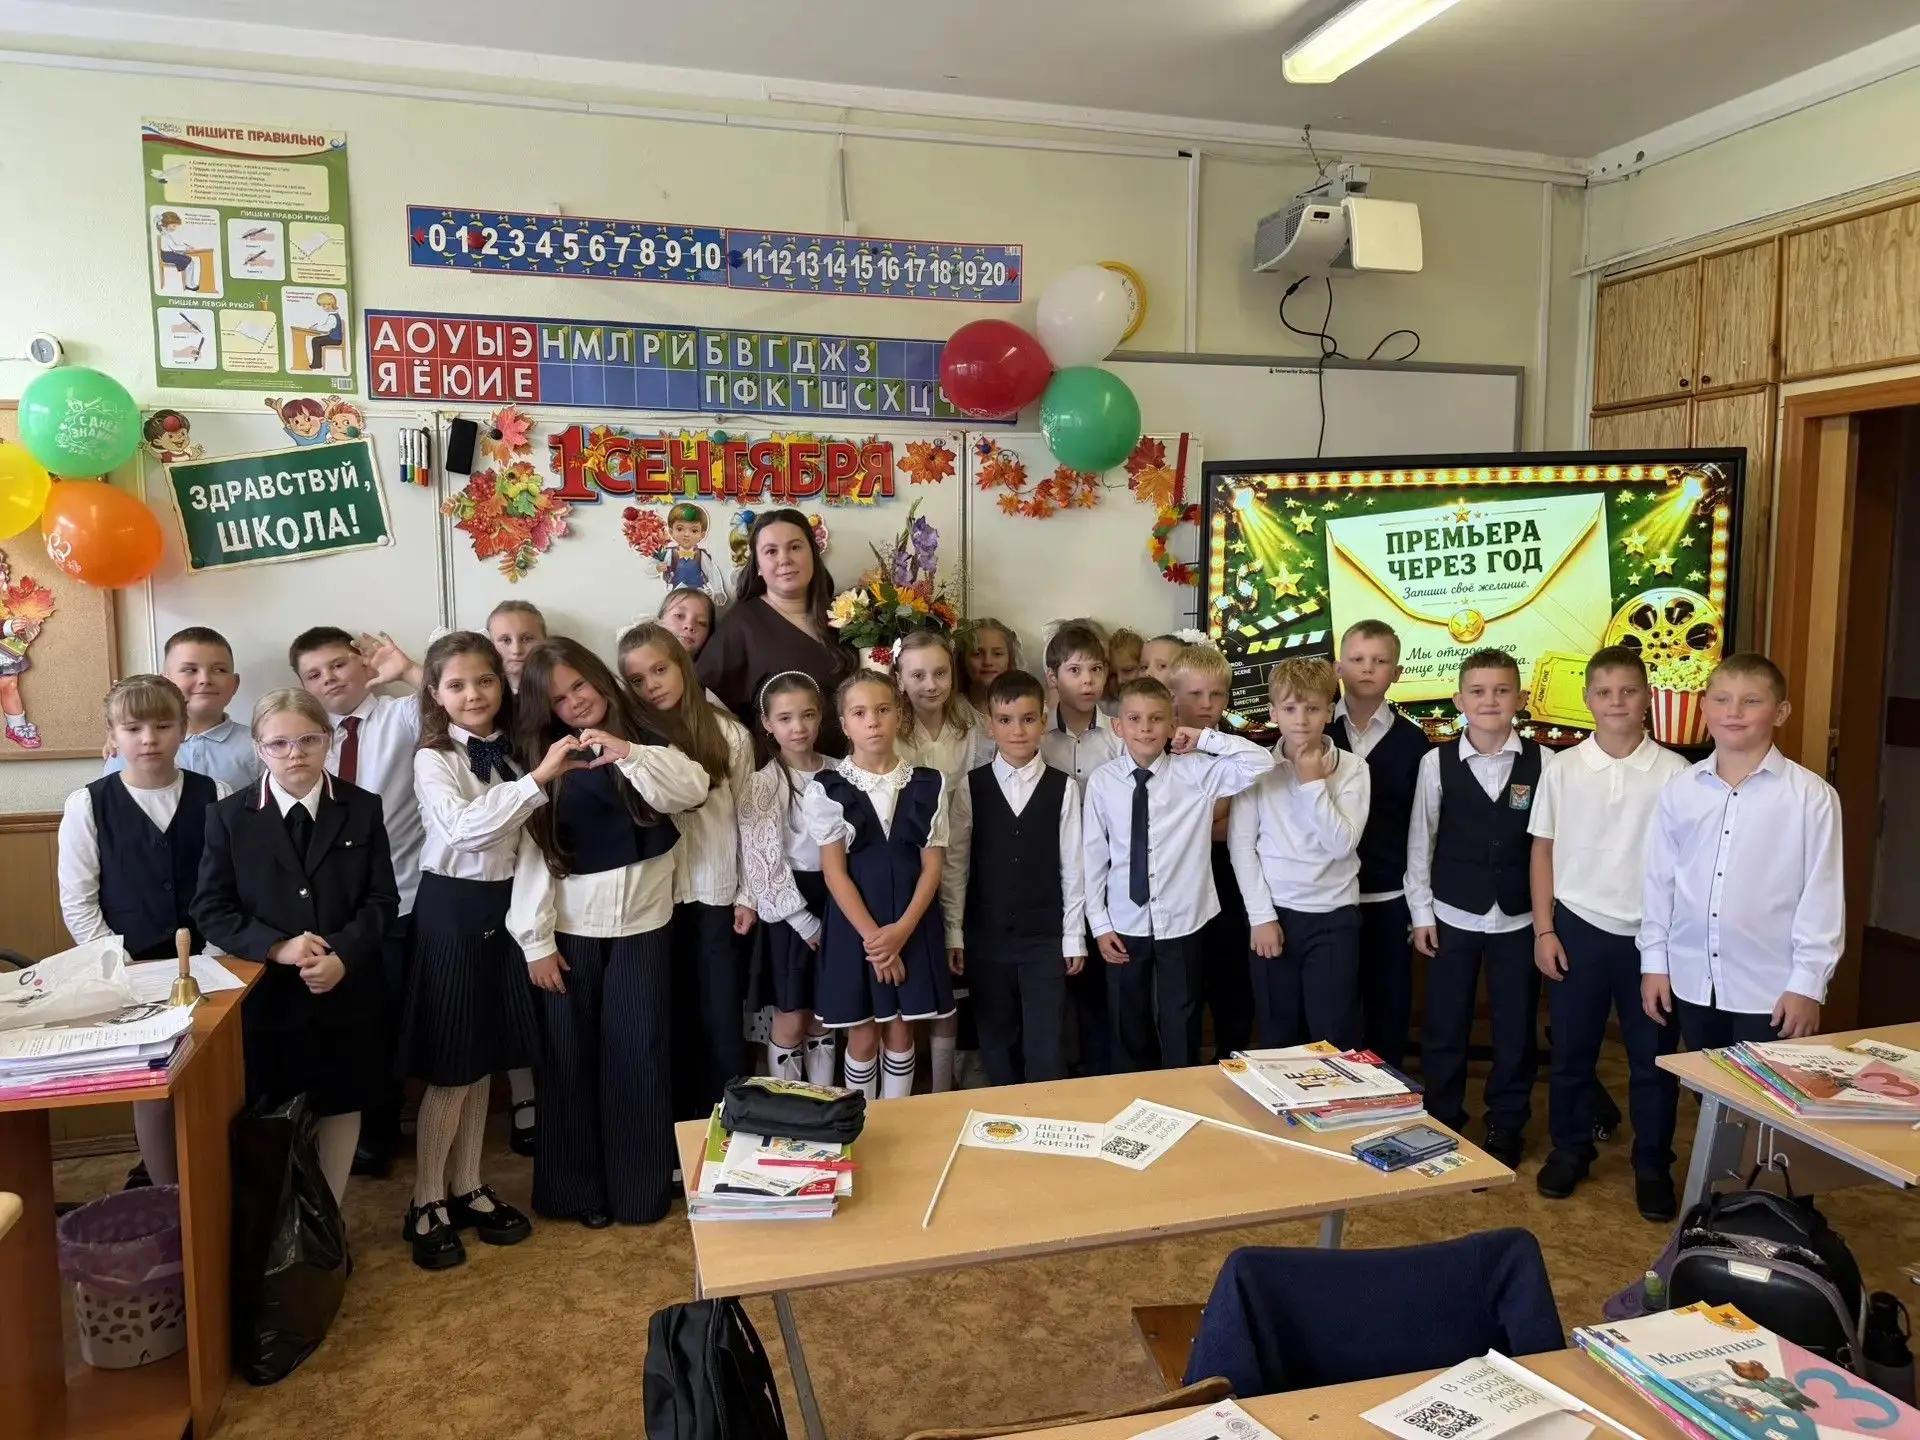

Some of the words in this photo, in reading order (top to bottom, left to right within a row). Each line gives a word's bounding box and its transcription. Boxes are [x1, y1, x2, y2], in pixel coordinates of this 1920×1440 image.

[186, 125, 244, 140] ПИШИТЕ
[247, 130, 326, 147] ПРАВИЛЬНО
[240, 210, 270, 219] ПИШЕМ
[272, 212, 304, 220] ПРАВОЙ
[305, 213, 330, 222] РУКОЙ
[429, 223, 446, 251] 0
[455, 226, 469, 253] 1
[481, 227, 499, 255] 2
[509, 229, 526, 257] 3
[535, 231, 553, 258] 4
[563, 233, 579, 260] 5
[589, 235, 606, 262] 6
[614, 236, 631, 263] 7
[640, 238, 656, 265] 8
[665, 240, 681, 267] 9
[690, 241, 721, 270] 10
[743, 248, 763, 273] 11
[768, 249, 792, 275] 12
[796, 251, 819, 276] 13
[823, 253, 848, 278] 14
[850, 255, 873, 280] 15
[877, 256, 900, 280] 16
[904, 257, 926, 282] 17
[930, 260, 951, 284] 18
[958, 261, 977, 285] 19
[980, 262, 1006, 286] 20
[168, 299, 199, 307] ПИШЕМ
[201, 300, 227, 308] ЛЕВОЙ
[228, 301, 255, 309] РУКОЙ
[548, 424, 599, 500] 1
[594, 437, 894, 497] СЕНТЯБРЯ
[189, 461, 371, 513] ЗДРАВСТВУЙ,
[216, 503, 361, 553] ШКОЛА!
[1386, 519, 1541, 555] ПРЕМЬЕРА
[1387, 553, 1477, 581] ЧЕРЕЗ
[1487, 547, 1543, 574] ГОД
[1403, 586, 1447, 600] Запиши
[1451, 582, 1475, 595] своё
[1478, 580, 1530, 593] желание.
[1406, 647, 1433, 661] Мы
[1234, 668, 1251, 676] SCENE
[1401, 664, 1434, 677] онце
[1542, 670, 1550, 682] ONE
[1233, 697, 1260, 706] DIRECTOR
[1861, 1072, 1919, 1098] 3
[1036, 1123, 1077, 1133] ДЕТИ
[1033, 1139, 1090, 1149] ЖИЗНИ
[1648, 1338, 1767, 1367] Математика
[1440, 1383, 1458, 1392] В
[1795, 1367, 1900, 1430] 3
